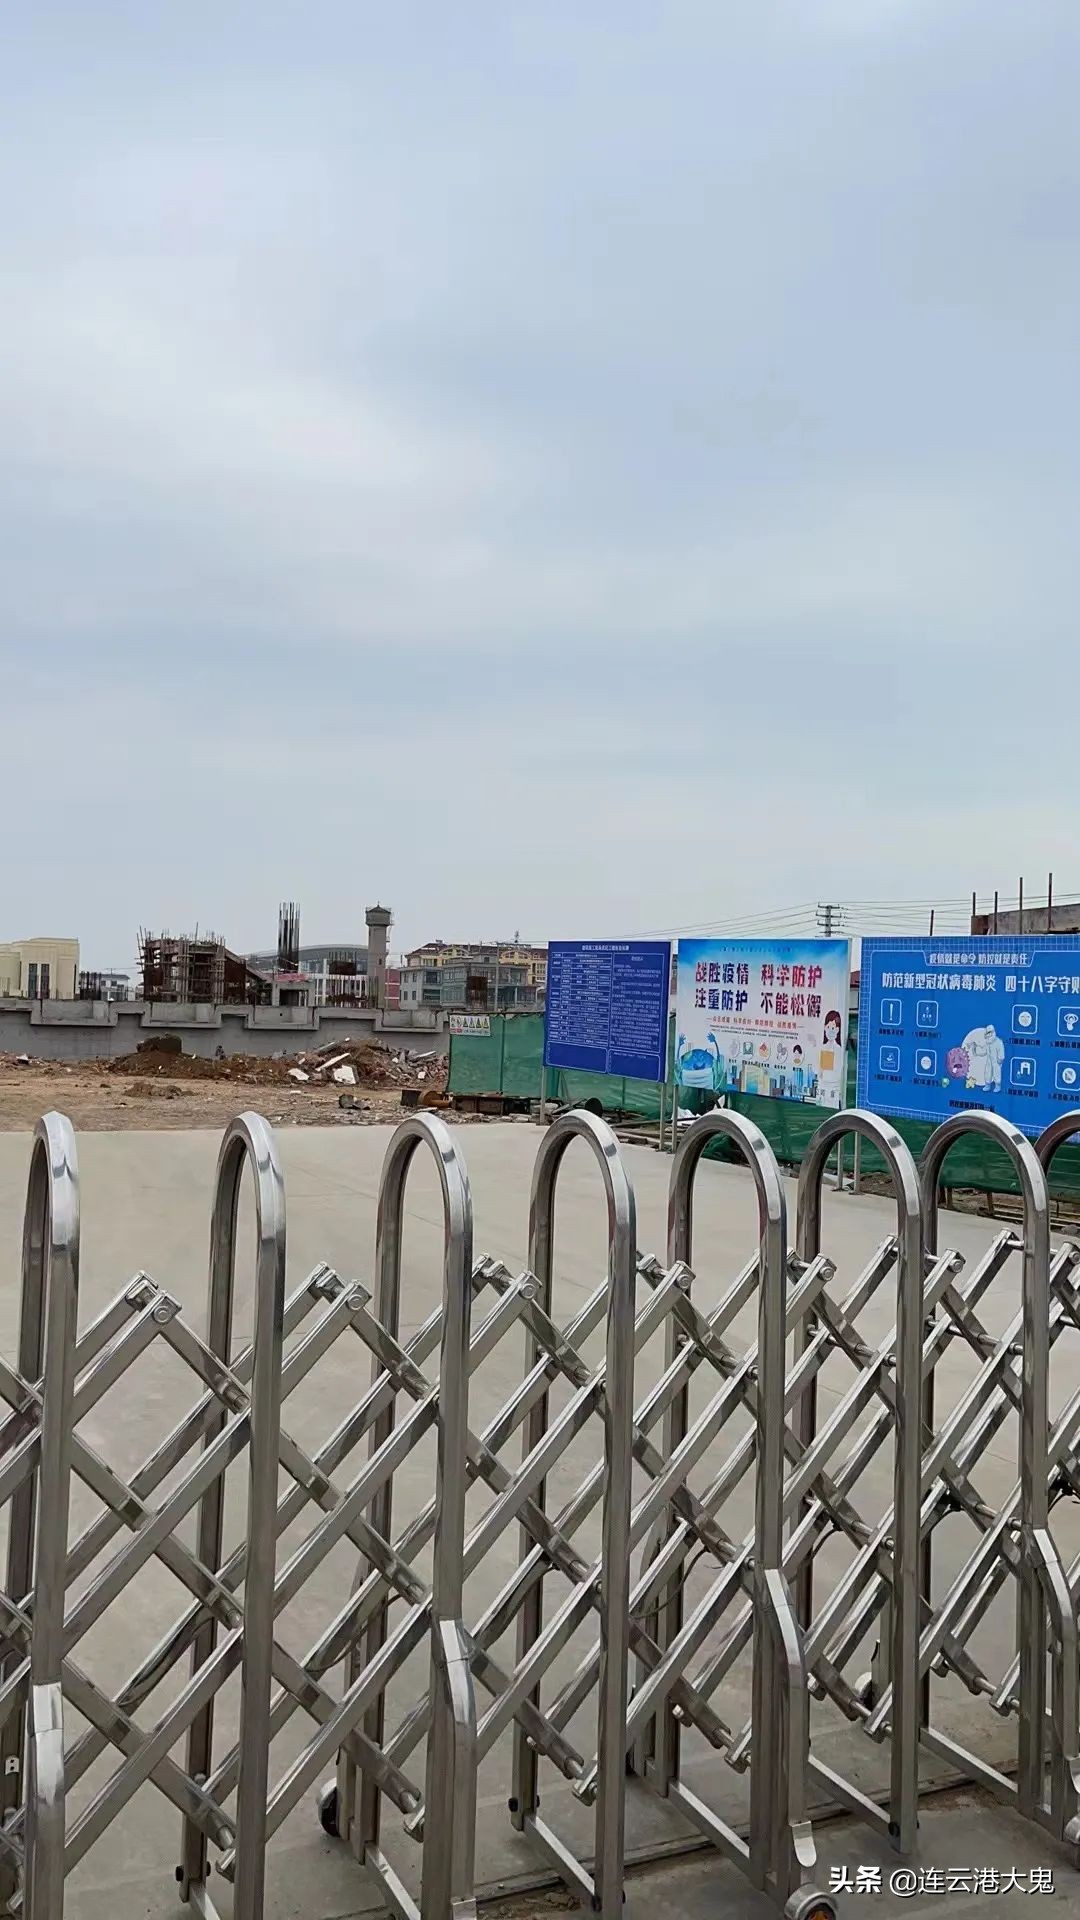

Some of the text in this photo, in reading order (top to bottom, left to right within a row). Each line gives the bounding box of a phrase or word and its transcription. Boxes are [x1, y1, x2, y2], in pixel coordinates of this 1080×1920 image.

[695, 961, 822, 988] 战胜疫情 科学防护
[882, 972, 996, 992] 防范新型冠状病毒肺炎
[694, 988, 822, 1018] 注重防护 不能松懈
